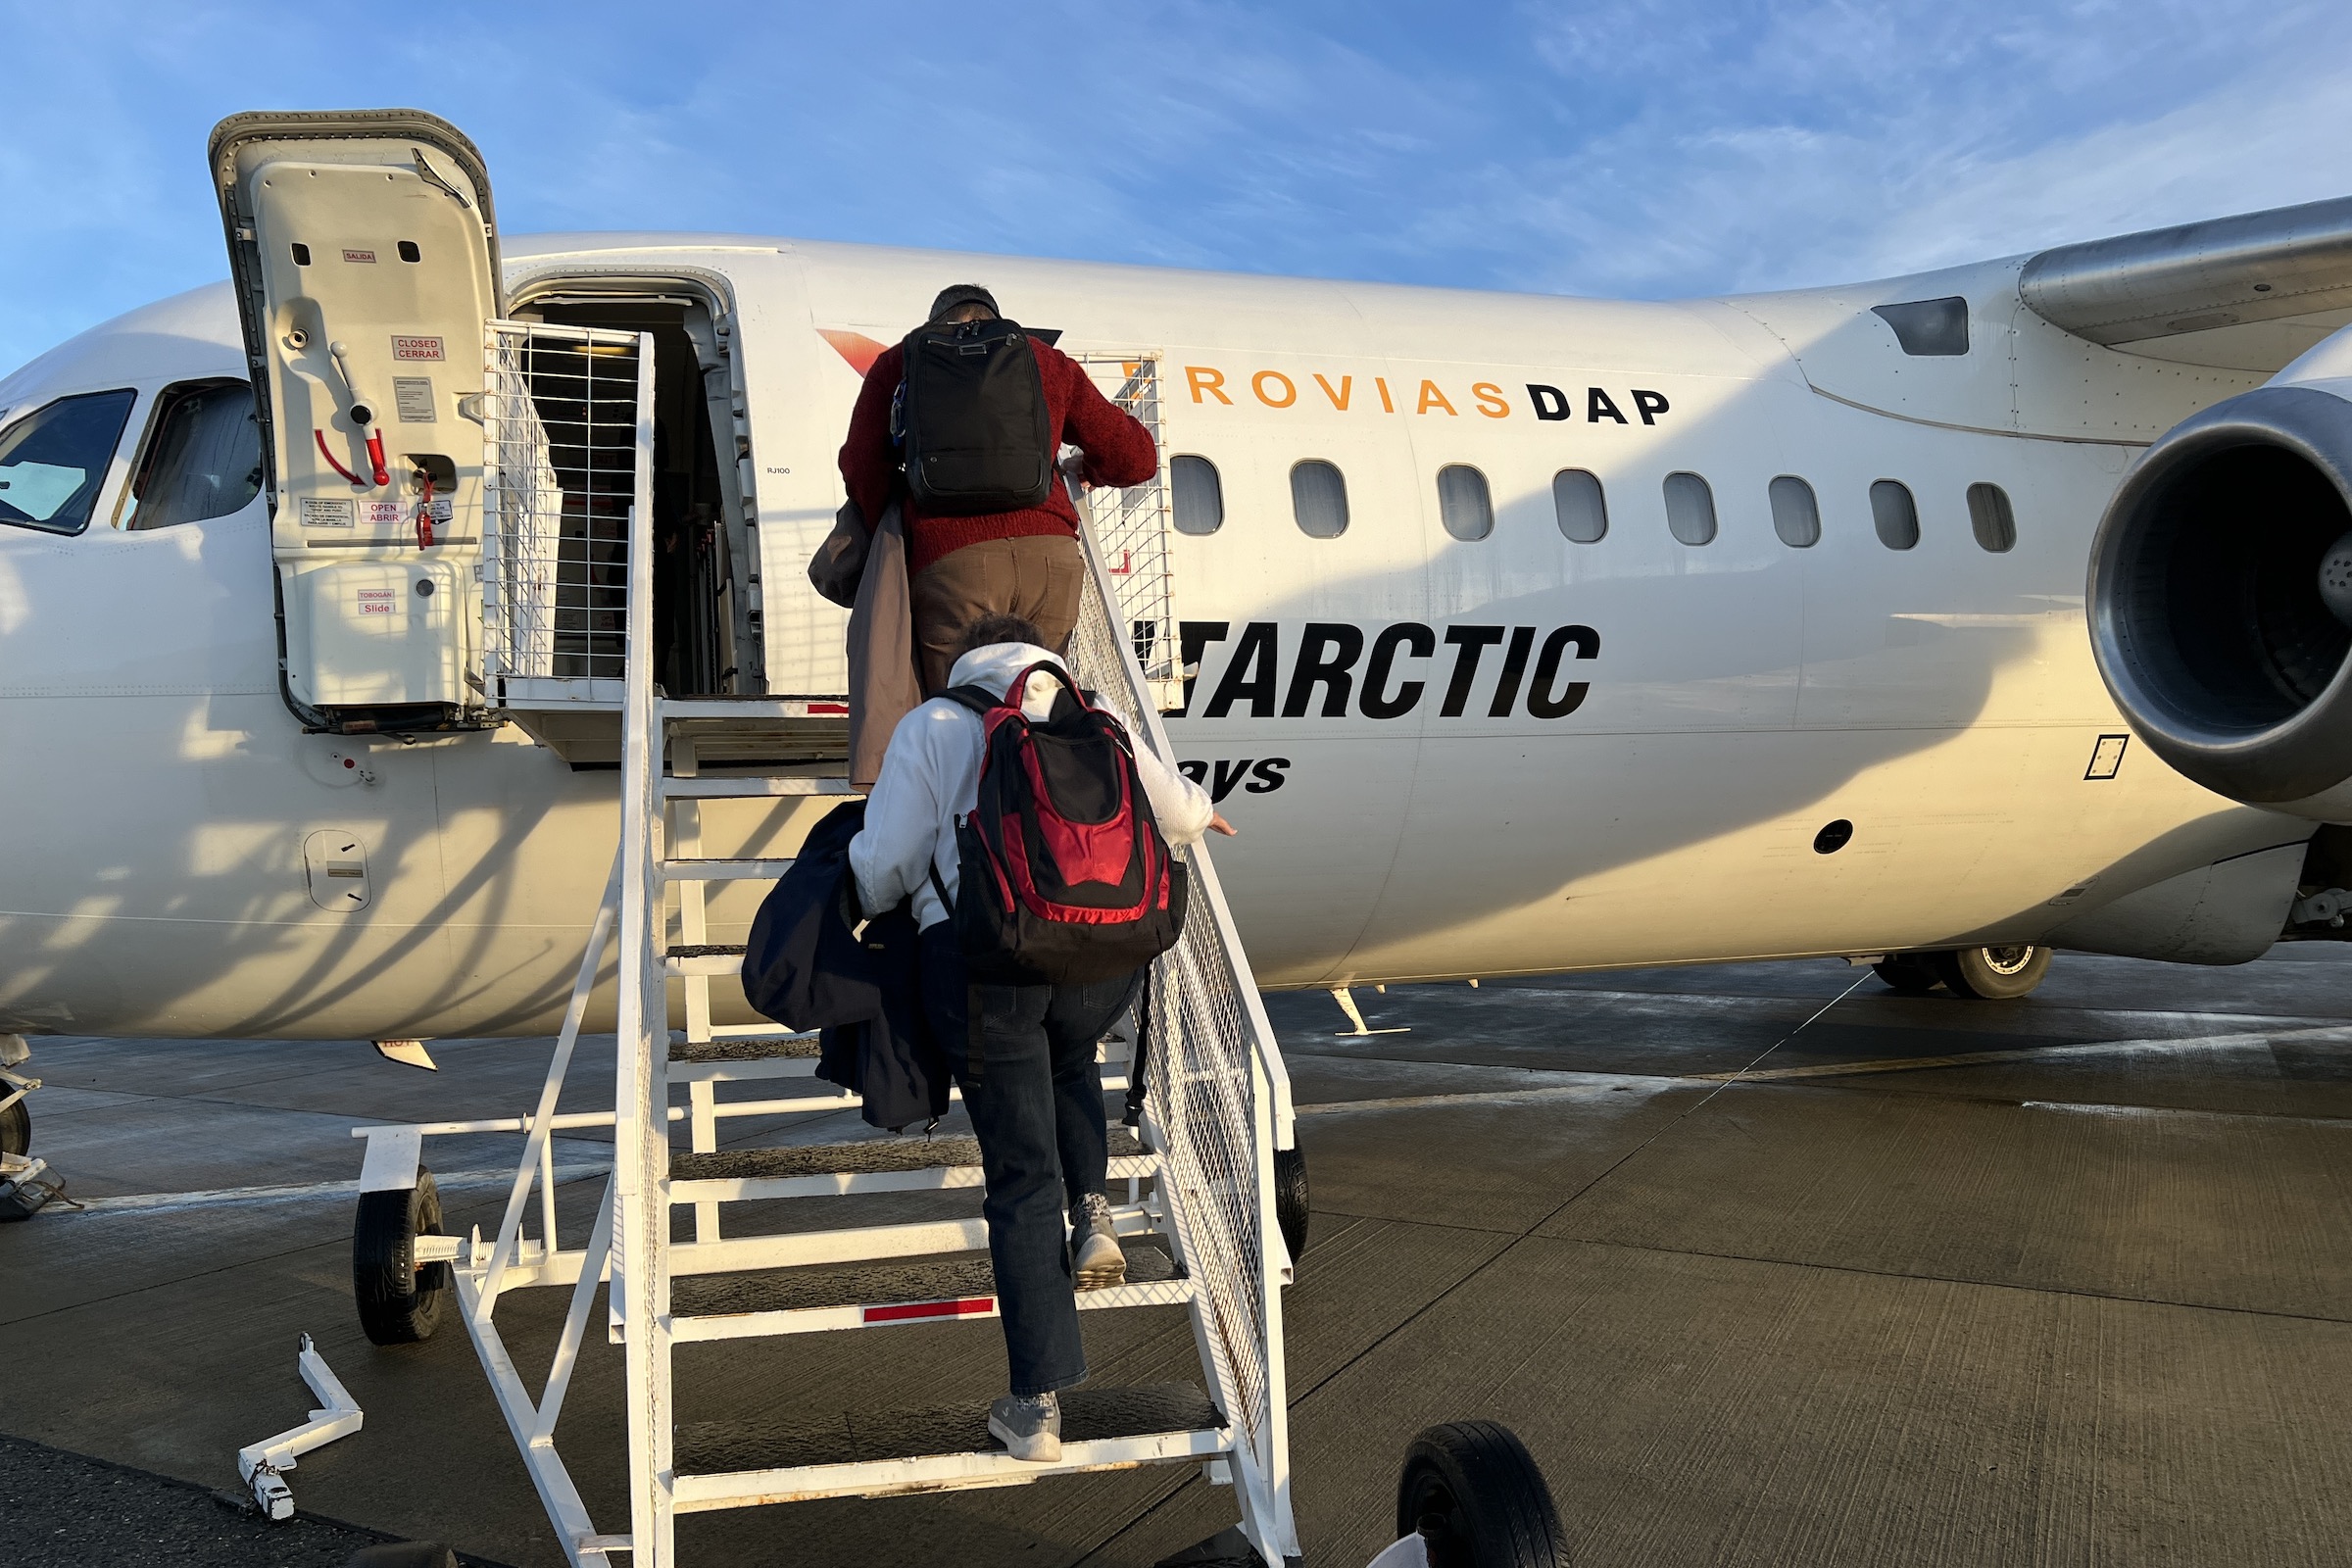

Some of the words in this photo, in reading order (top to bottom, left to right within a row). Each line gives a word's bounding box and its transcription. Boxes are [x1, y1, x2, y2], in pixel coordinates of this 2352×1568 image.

[346, 252, 372, 261] SALIDA
[398, 339, 438, 348] CLOSED
[398, 349, 440, 359] CERRAR
[1121, 362, 1510, 419] ROVIAS
[1526, 383, 1670, 426] DAP
[365, 604, 390, 612] Slide
[1134, 621, 1600, 720] TARCTIC
[1177, 757, 1292, 805] ays
